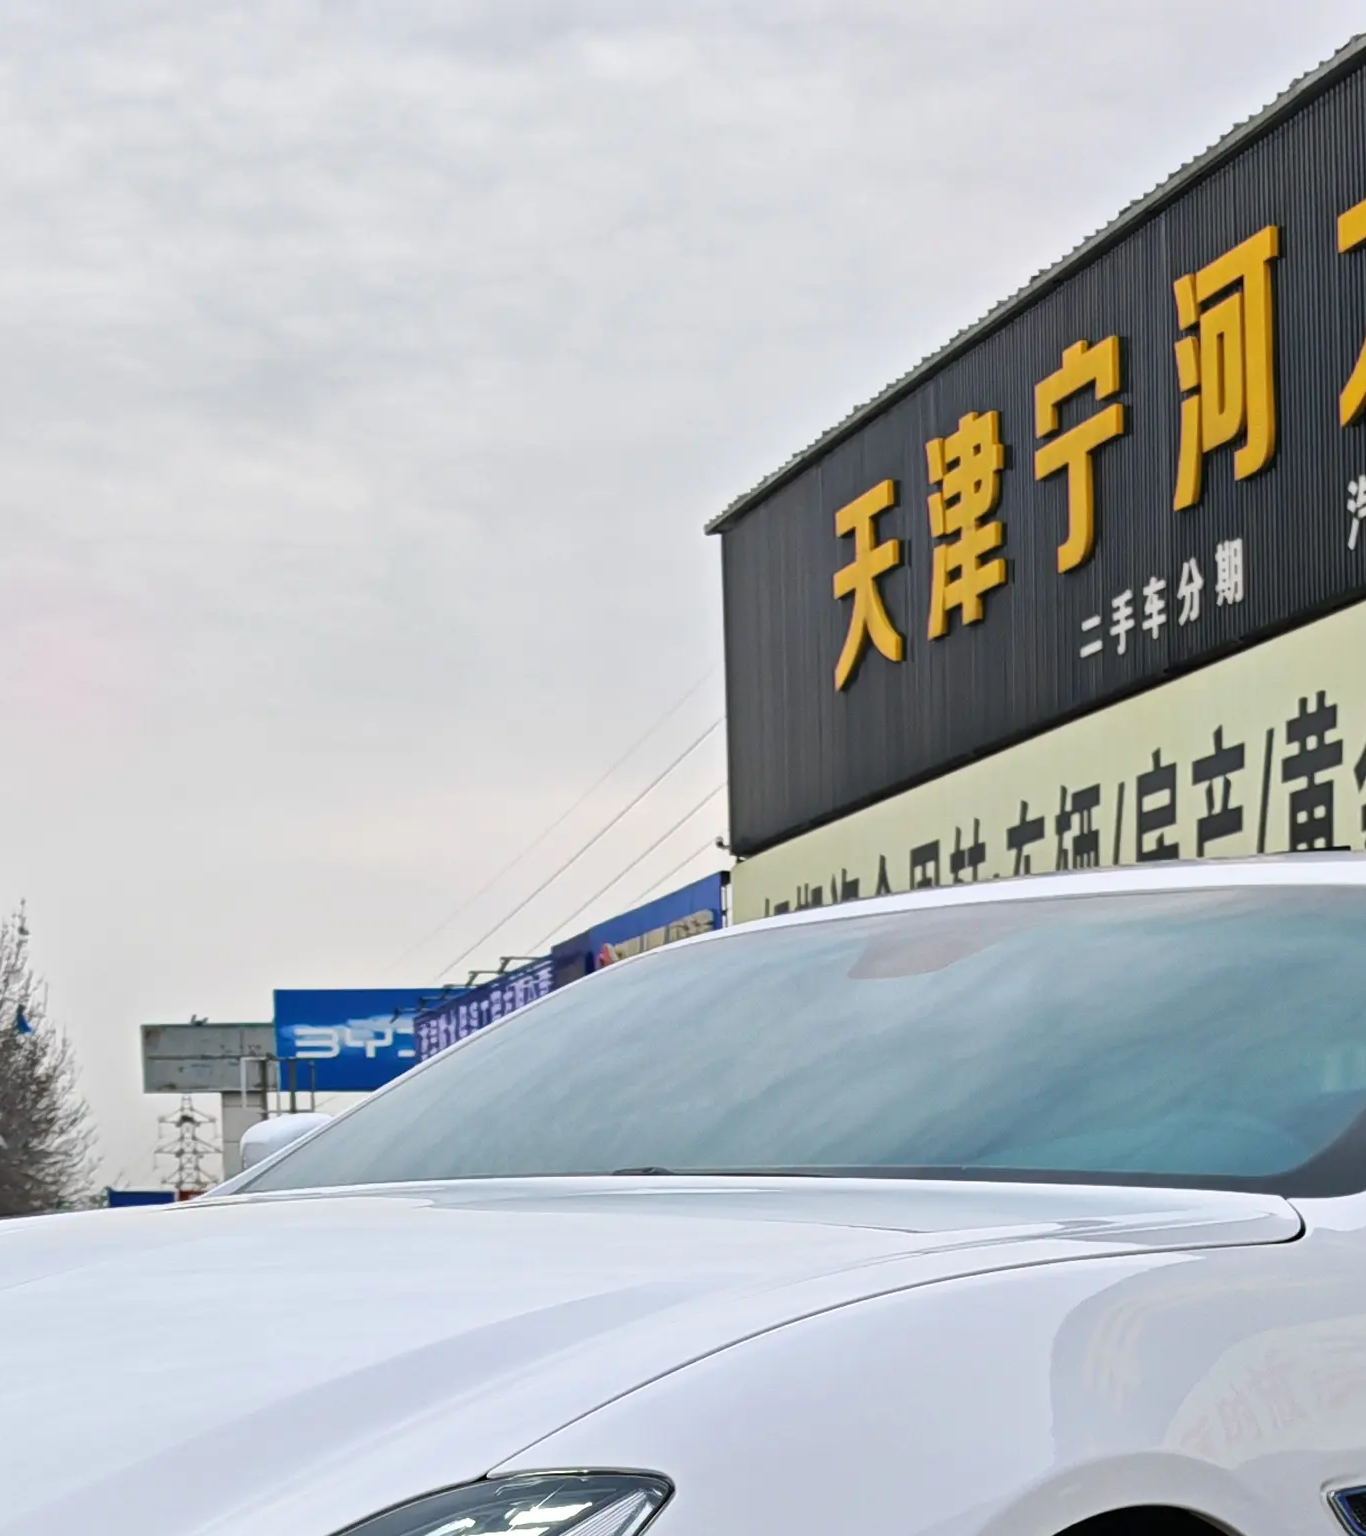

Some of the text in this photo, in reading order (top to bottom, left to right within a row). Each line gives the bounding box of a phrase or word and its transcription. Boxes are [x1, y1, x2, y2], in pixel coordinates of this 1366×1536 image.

[1079, 538, 1245, 659] 二手车分期
